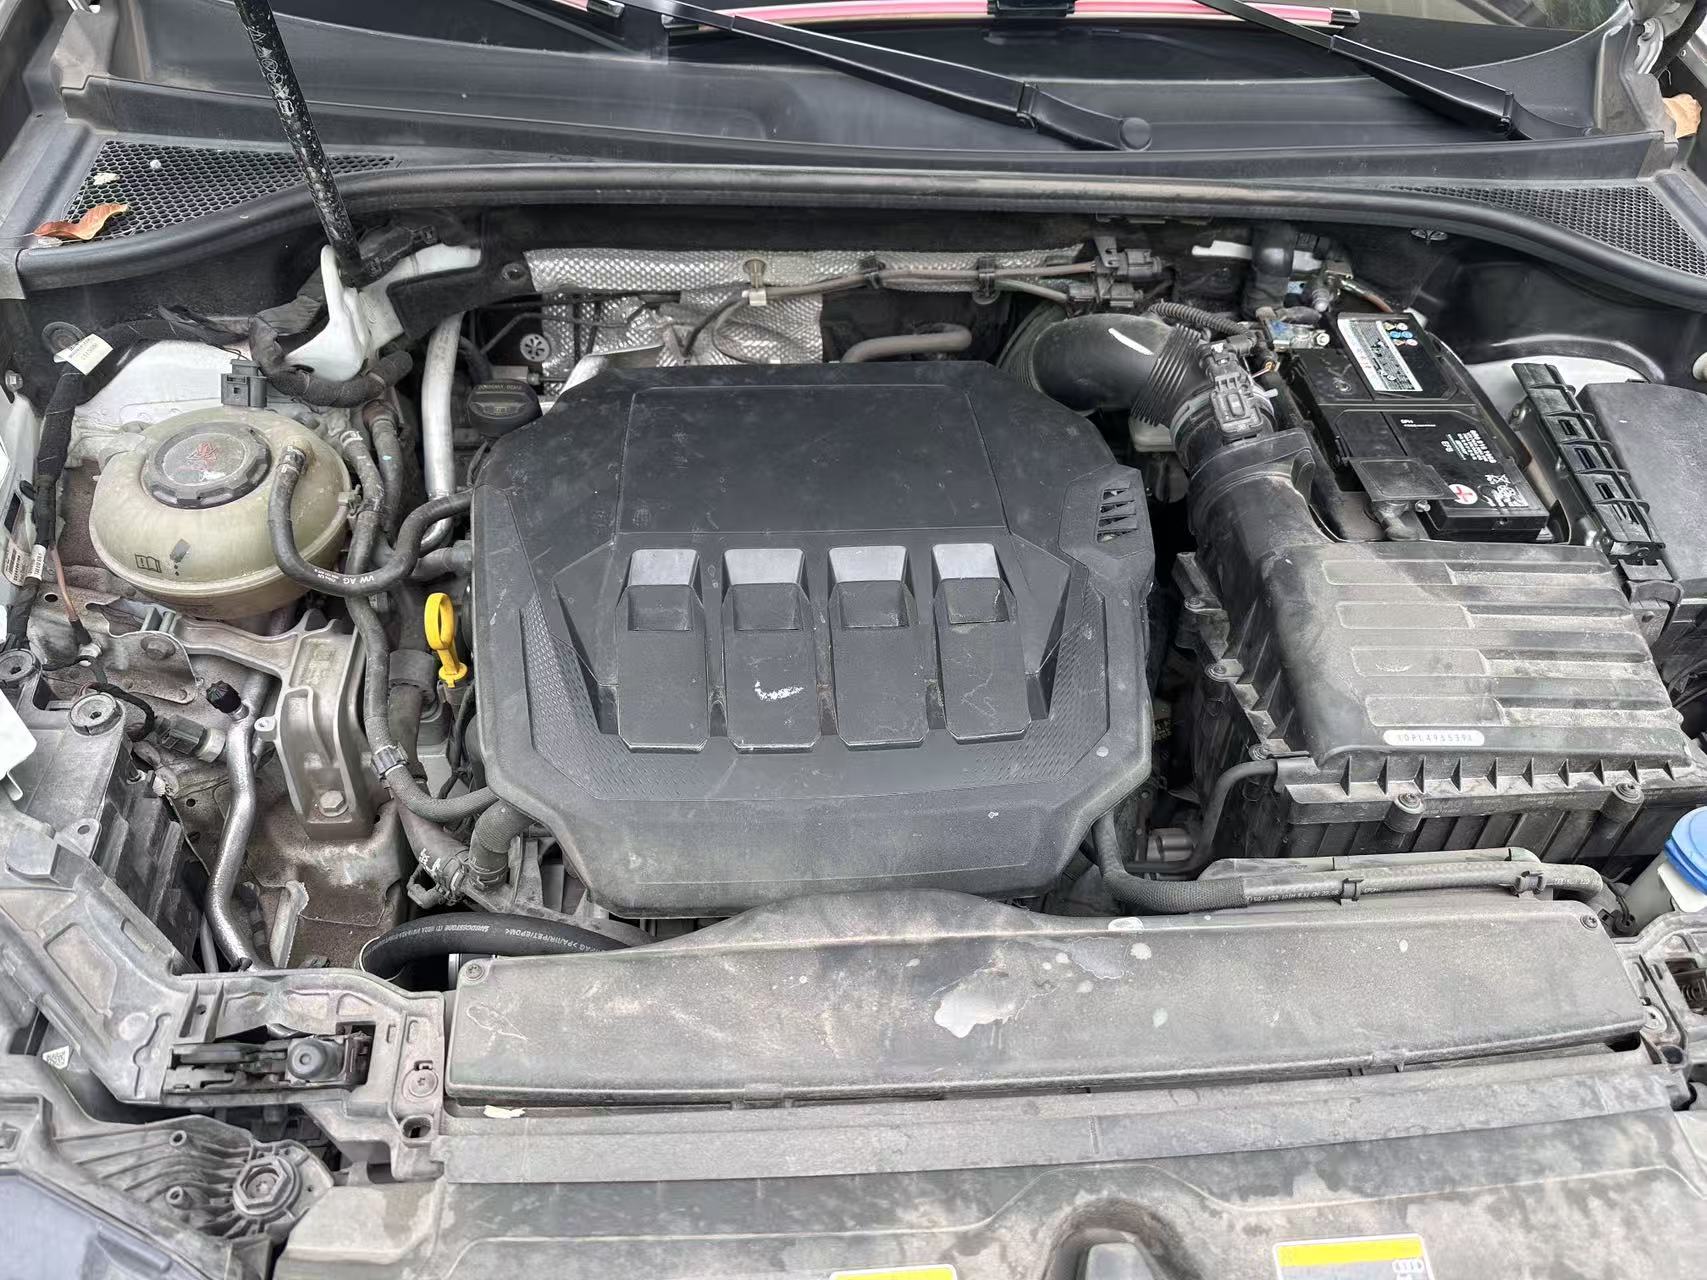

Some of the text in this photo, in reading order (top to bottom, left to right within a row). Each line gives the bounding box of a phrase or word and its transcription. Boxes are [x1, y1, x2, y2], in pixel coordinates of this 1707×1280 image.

[1440, 440, 1454, 452] EFB
[343, 575, 375, 585] VW AG
